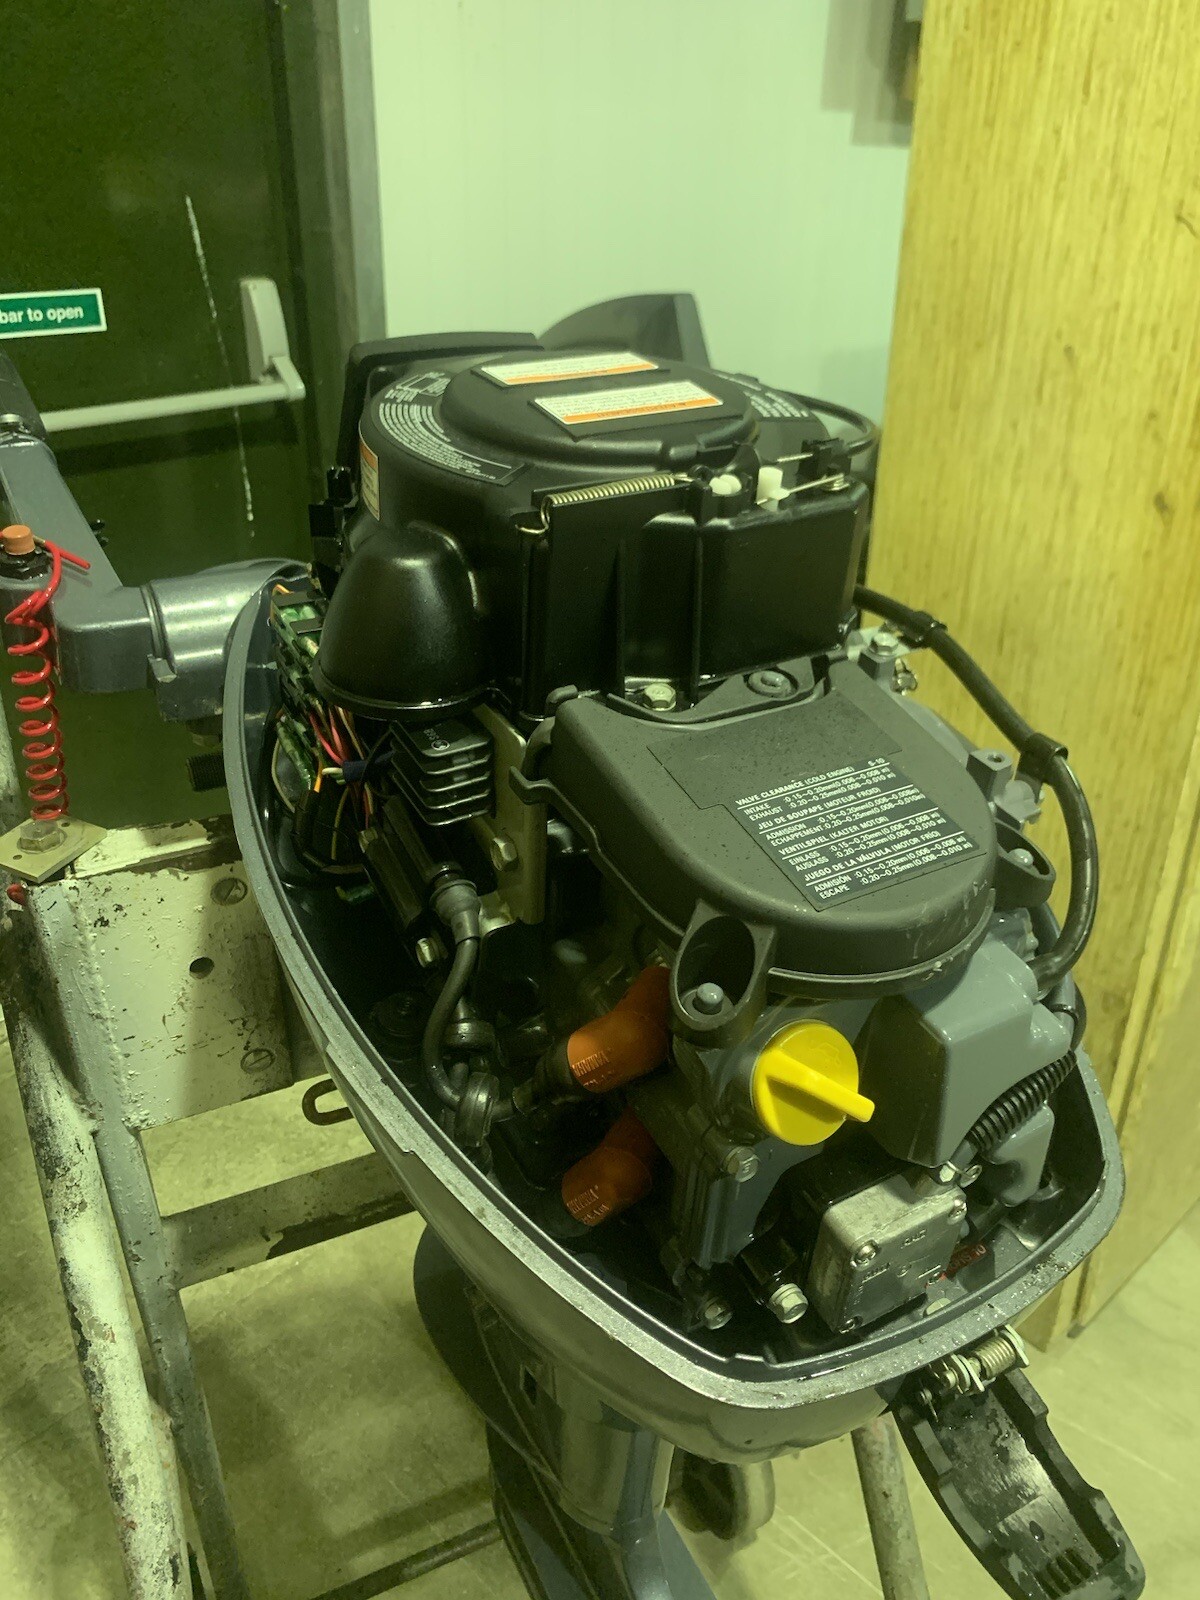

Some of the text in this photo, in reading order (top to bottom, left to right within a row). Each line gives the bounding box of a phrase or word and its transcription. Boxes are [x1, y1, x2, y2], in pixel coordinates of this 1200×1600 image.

[0, 306, 83, 324] bar to open
[734, 794, 761, 805] VALVE
[759, 781, 805, 798] CLEARANCE
[803, 774, 828, 785] (COLD
[827, 766, 856, 778] ENGINE)
[743, 802, 771, 814] INTAKE
[748, 806, 784, 820] EXHAUST
[755, 787, 882, 829] JEU DE SOUPAPE (MOTEUR FROID)
[764, 823, 807, 840] ADMISSION
[777, 815, 889, 855] VENTILSPIEL (KALTER MOTOR)
[788, 850, 821, 865] EINLASS
[793, 855, 830, 871] AUSLASS
[801, 866, 833, 881] JUEGO
[831, 862, 846, 871] DE
[843, 858, 858, 867] LA
[854, 846, 892, 863] VÁLVULA
[890, 837, 921, 851] (MOTOR
[811, 873, 852, 892] ADMISIÓN
[818, 883, 850, 898] ESCAPE
